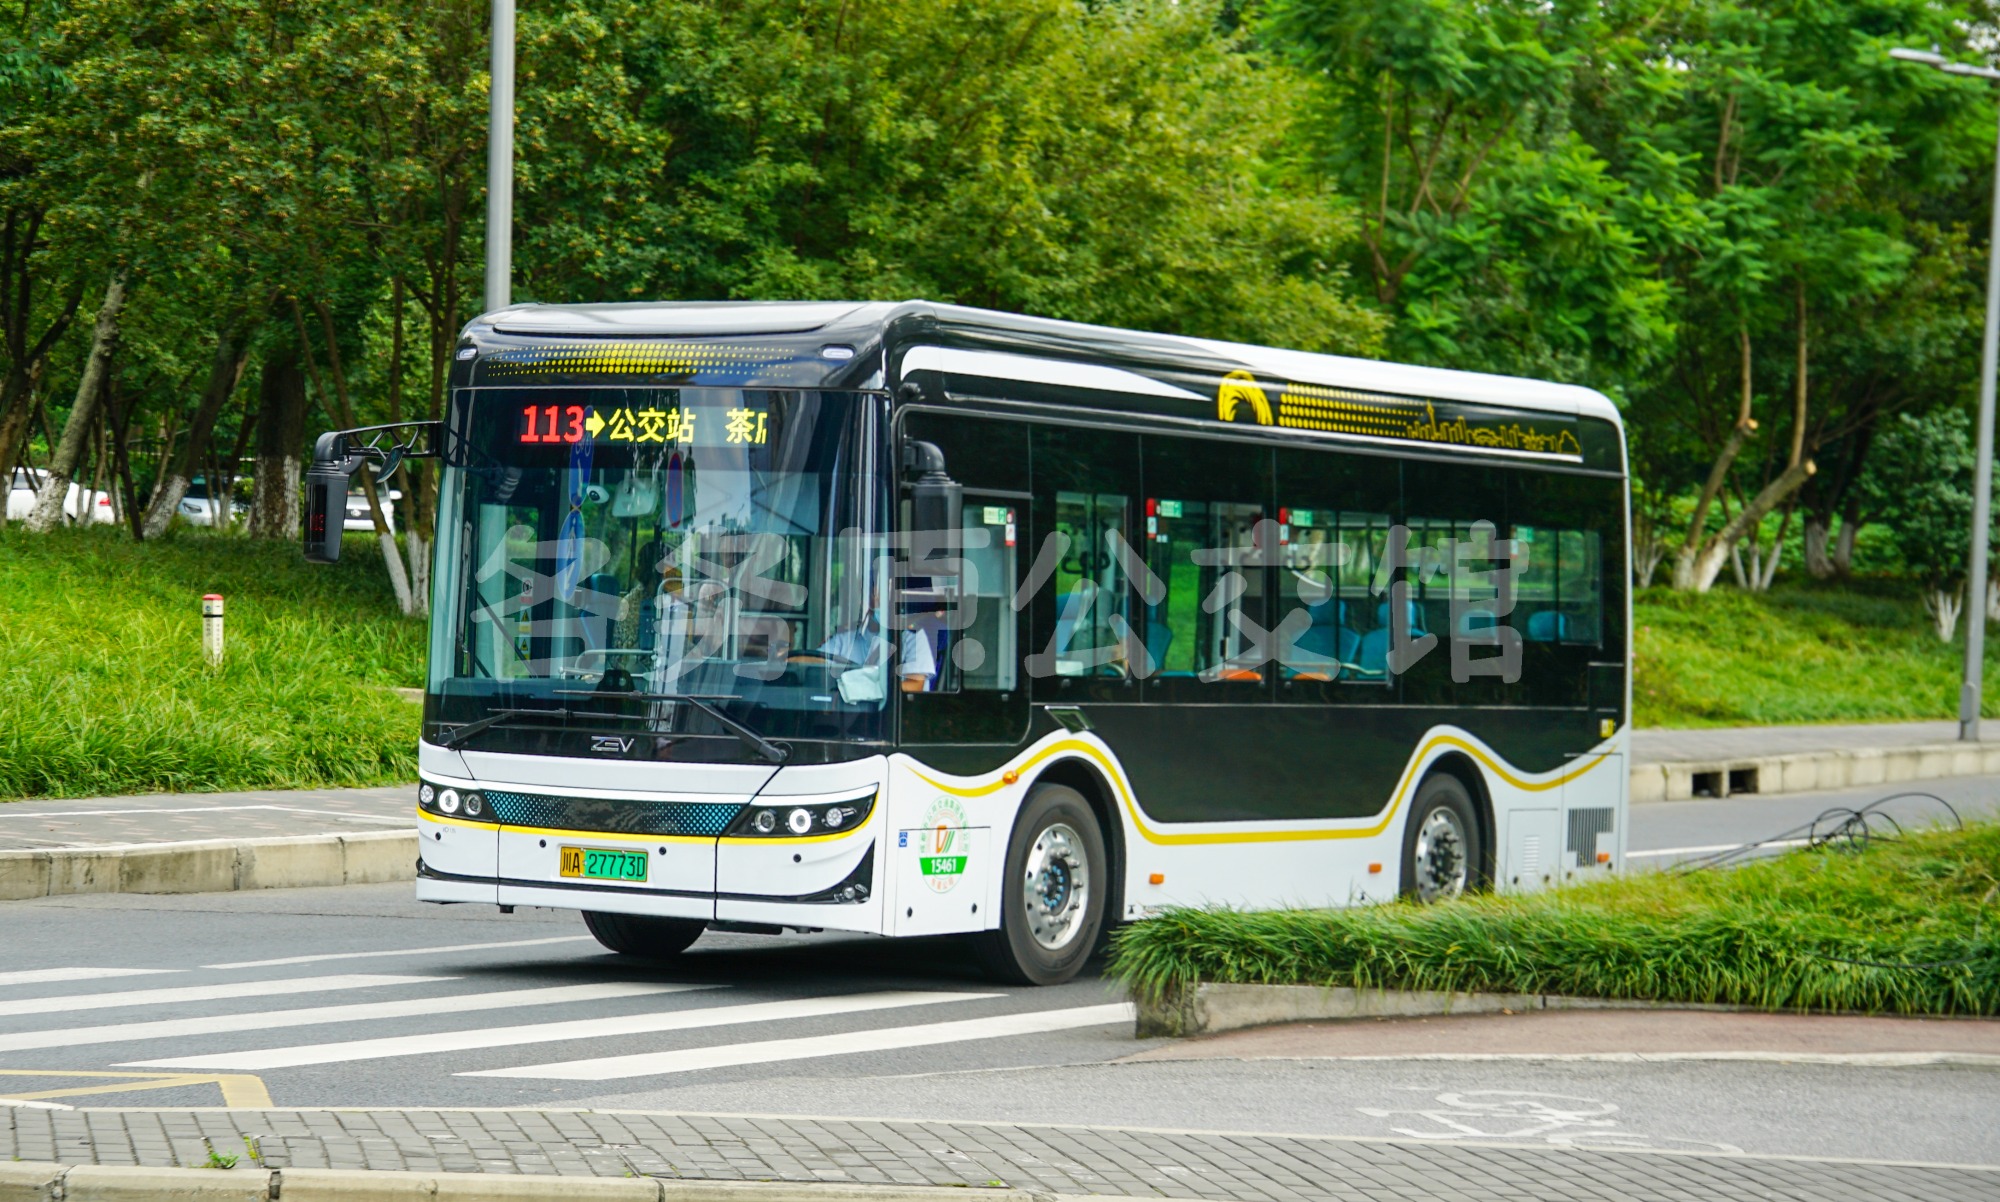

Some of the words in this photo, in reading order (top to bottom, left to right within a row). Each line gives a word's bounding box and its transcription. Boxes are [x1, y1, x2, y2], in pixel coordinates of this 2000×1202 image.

[520, 405, 586, 443] 113
[608, 406, 697, 443] 公交站
[590, 735, 635, 753] ZEV
[931, 858, 957, 874] 15461
